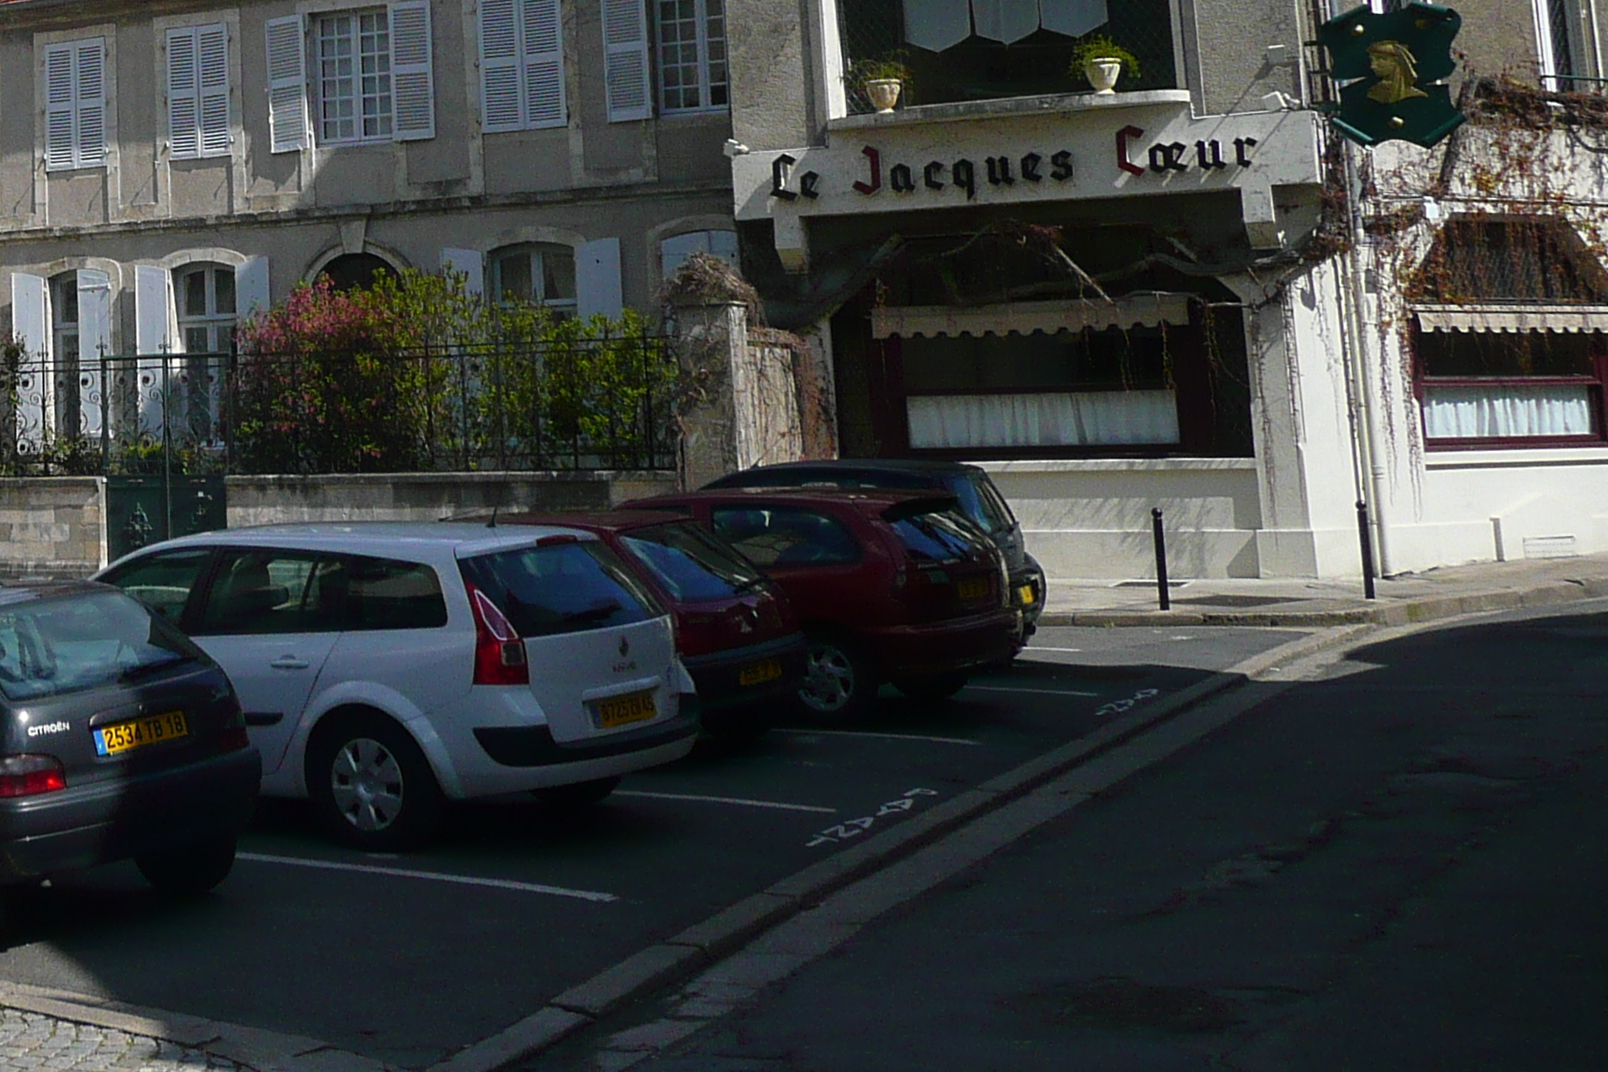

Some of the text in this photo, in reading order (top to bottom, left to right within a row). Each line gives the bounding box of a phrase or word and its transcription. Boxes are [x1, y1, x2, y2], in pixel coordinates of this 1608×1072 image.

[771, 125, 1258, 200] Le Jacques Cœur
[27, 721, 71, 737] CITROËN
[104, 714, 184, 750] 2534 TB 18
